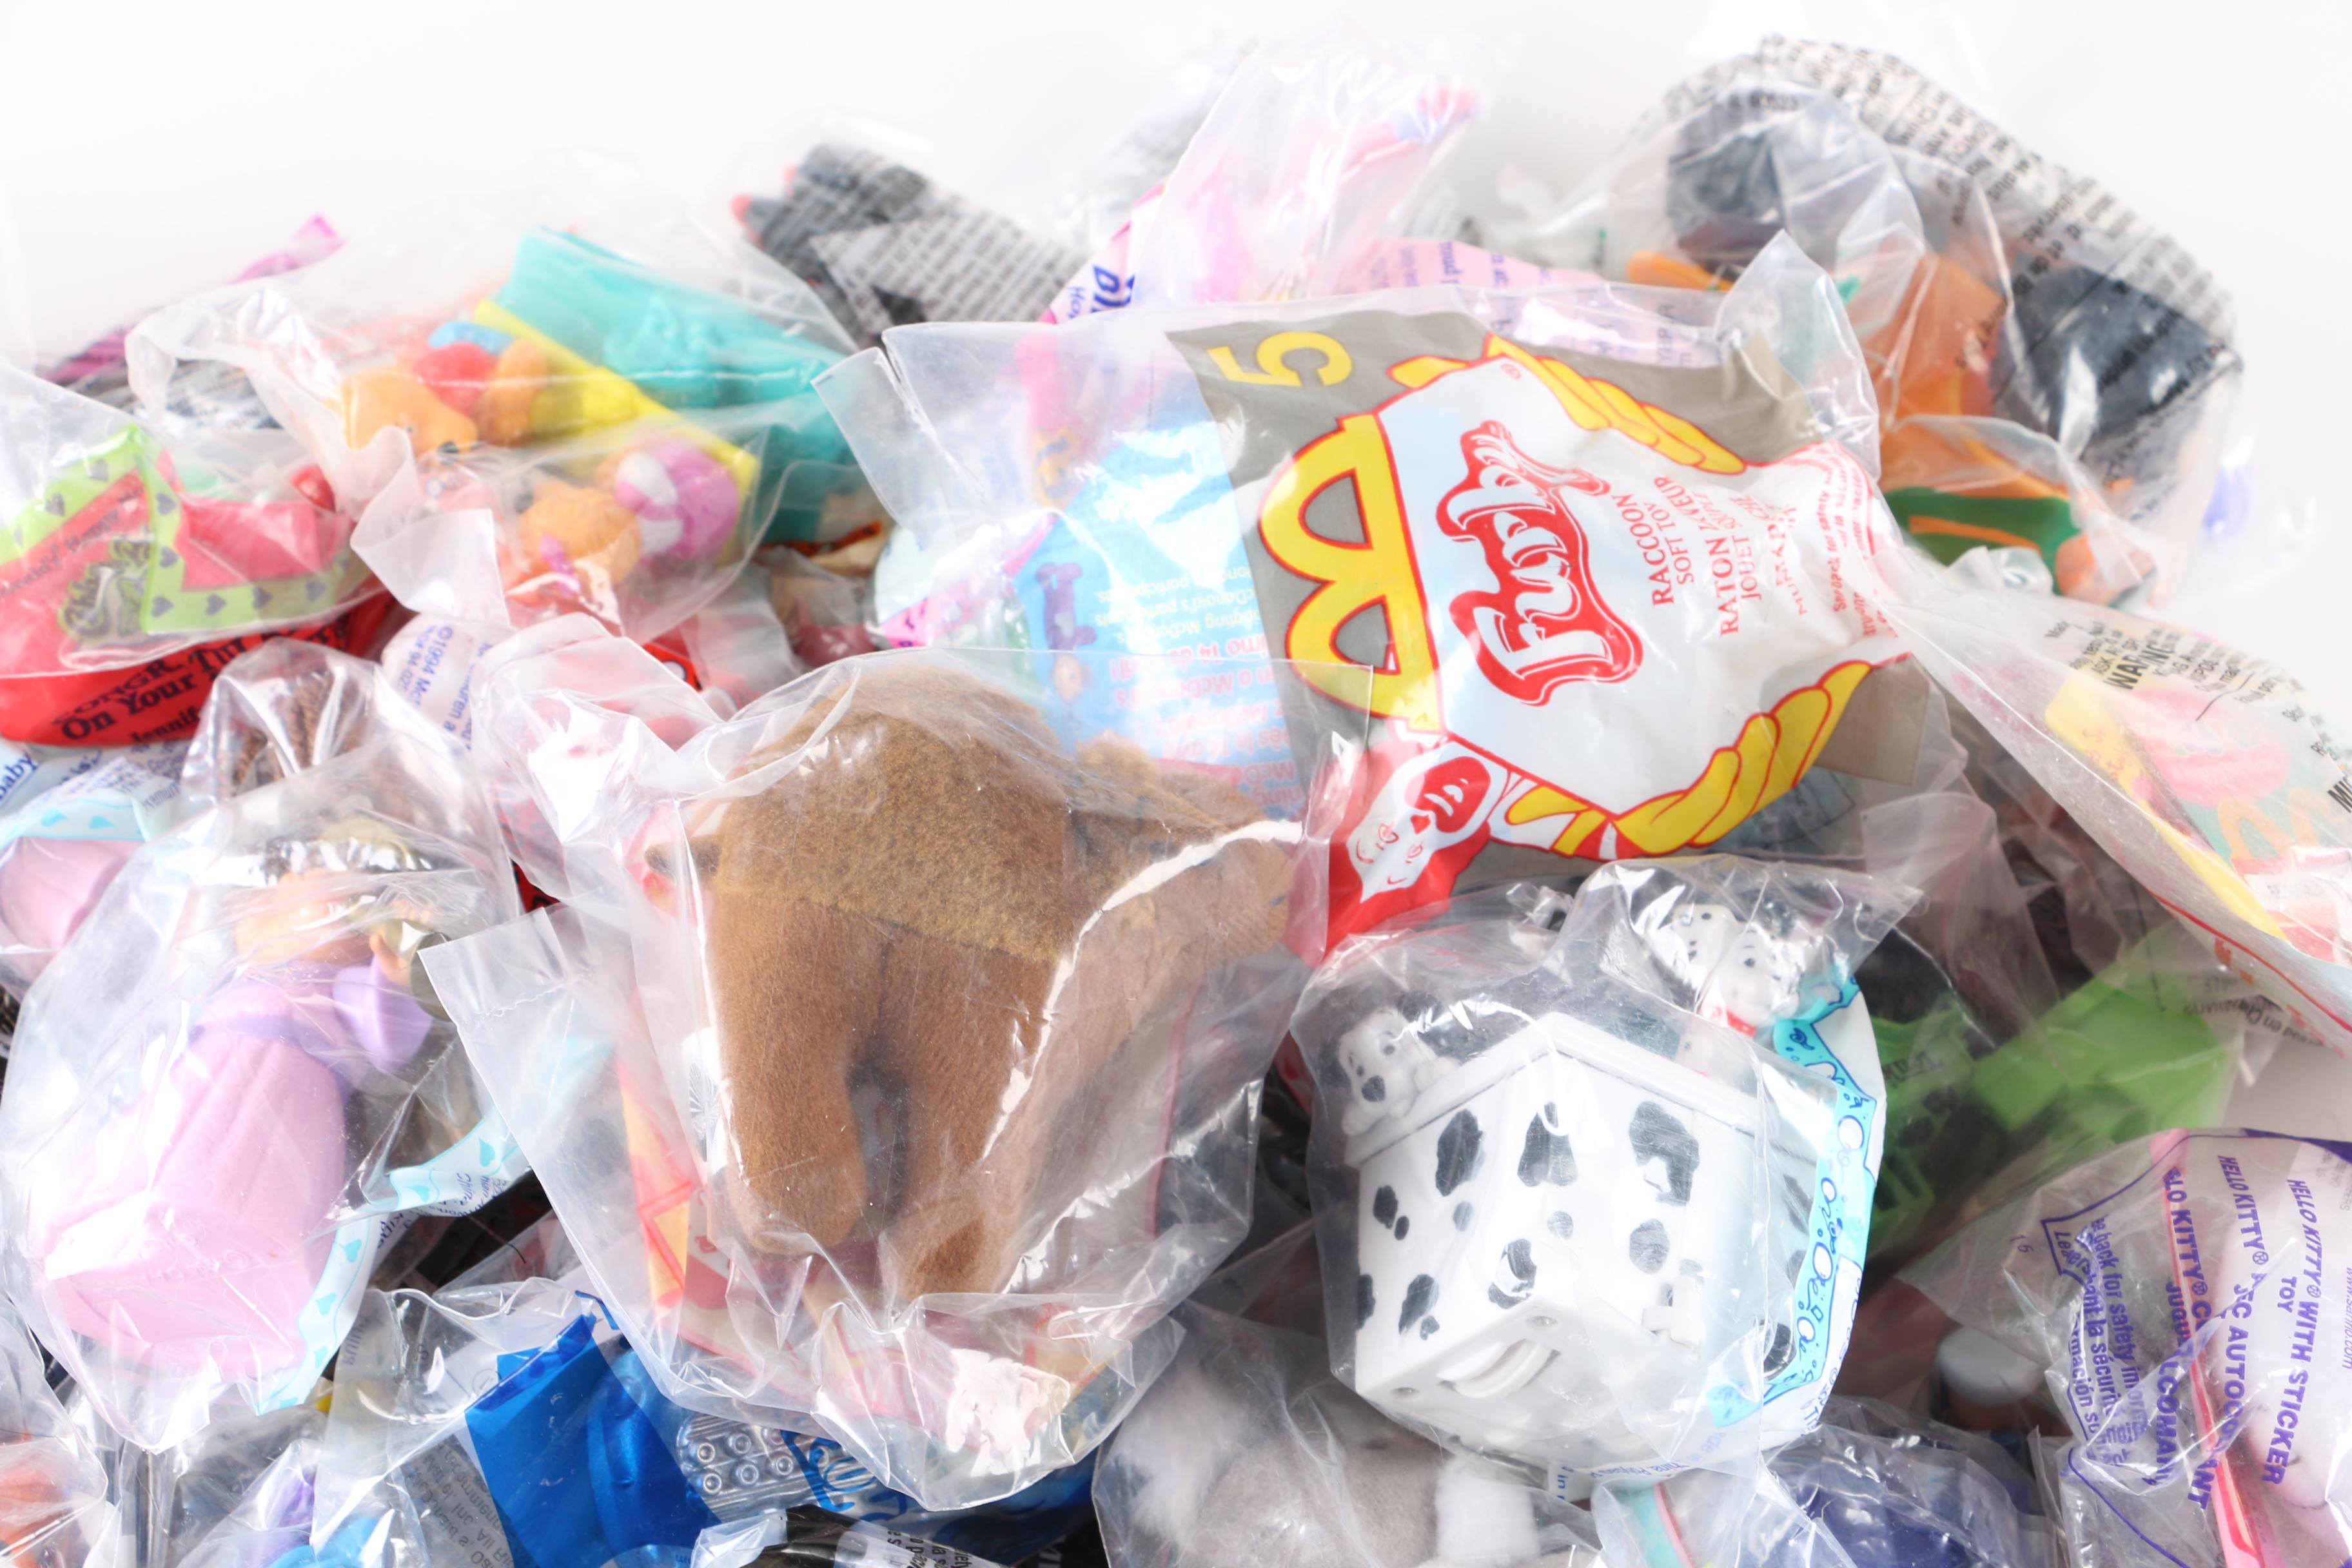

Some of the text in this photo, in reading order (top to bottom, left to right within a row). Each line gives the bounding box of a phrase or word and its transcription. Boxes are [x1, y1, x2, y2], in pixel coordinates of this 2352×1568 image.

[1443, 420, 1616, 686] Furby
[1612, 494, 1674, 607] RACCOON
[1643, 502, 1694, 585] SOFT TOY
[1732, 535, 1762, 600] JOUET
[1705, 537, 1739, 637] RATON
[61, 676, 199, 741] On Your
[131, 705, 200, 743] Jennif
[2218, 1155, 2249, 1191] HELLO
[2287, 1179, 2318, 1224] HELLO
[2095, 1231, 2120, 1269] back
[2102, 1272, 2123, 1298] for
[2277, 1275, 2297, 1313] TOY
[2084, 1318, 2105, 1337] la
[2109, 1303, 2137, 1362] safety
[2290, 1300, 2320, 1363] WITH
[2261, 1369, 2309, 1485] STICKER
